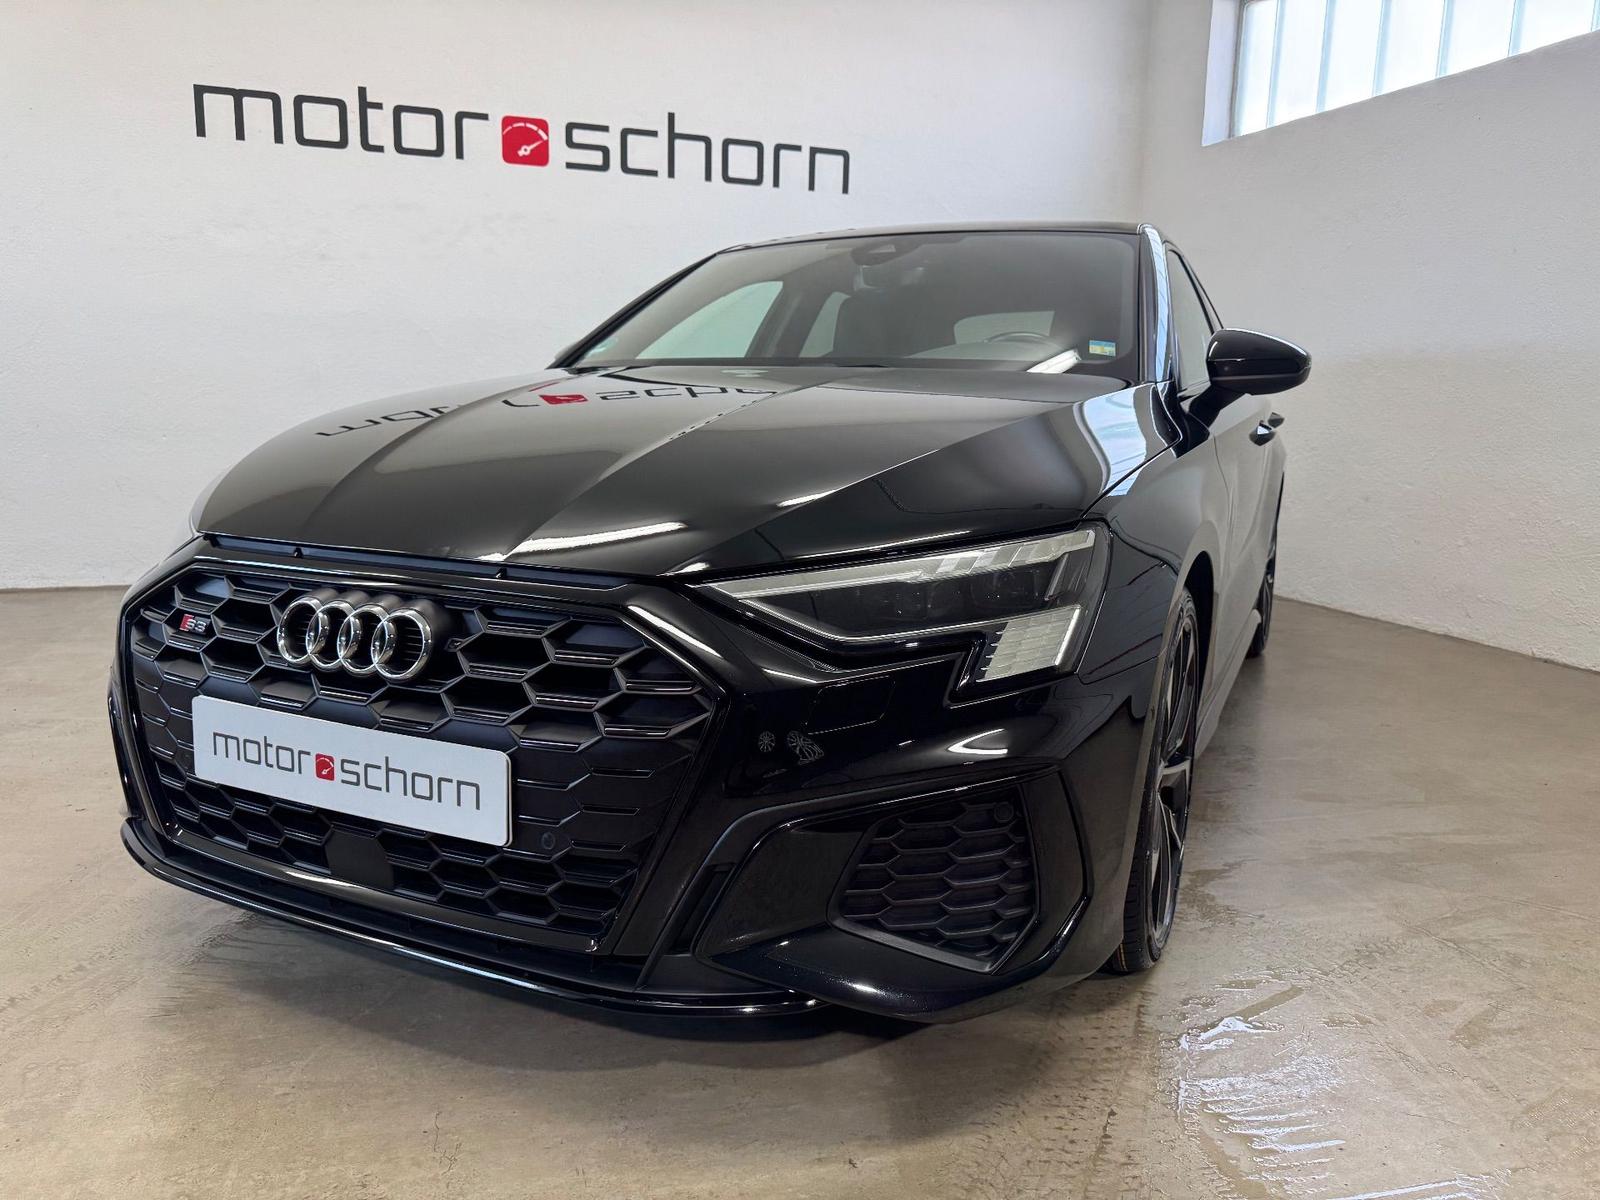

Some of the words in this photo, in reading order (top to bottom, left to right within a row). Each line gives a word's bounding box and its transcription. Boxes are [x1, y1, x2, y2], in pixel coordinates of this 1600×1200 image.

[193, 84, 489, 160] motor
[565, 112, 850, 194] schorn
[182, 615, 207, 632] S3
[213, 731, 311, 774] motor
[340, 756, 481, 810] schorn
